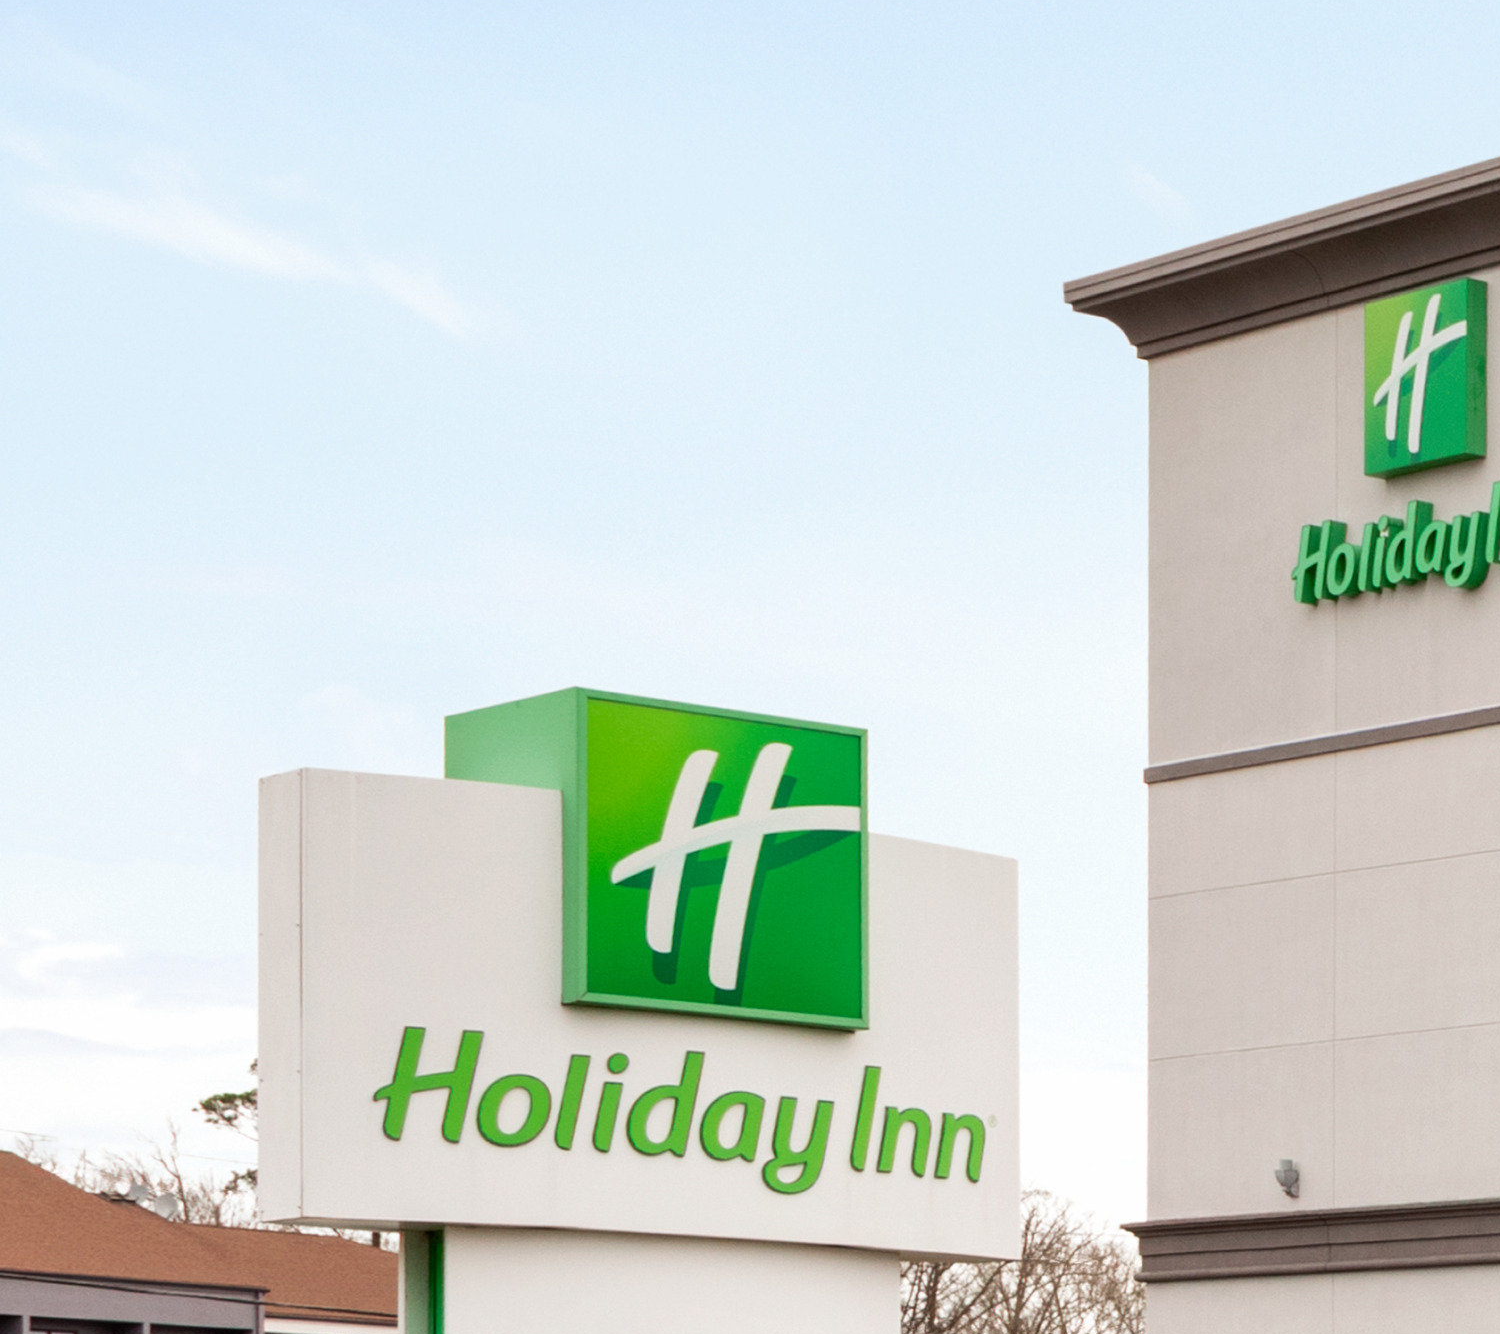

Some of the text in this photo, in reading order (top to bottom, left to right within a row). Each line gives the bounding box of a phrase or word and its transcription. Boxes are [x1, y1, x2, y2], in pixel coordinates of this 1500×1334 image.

[1291, 500, 1488, 605] Holiday
[373, 1026, 986, 1195] Holiday Inn
